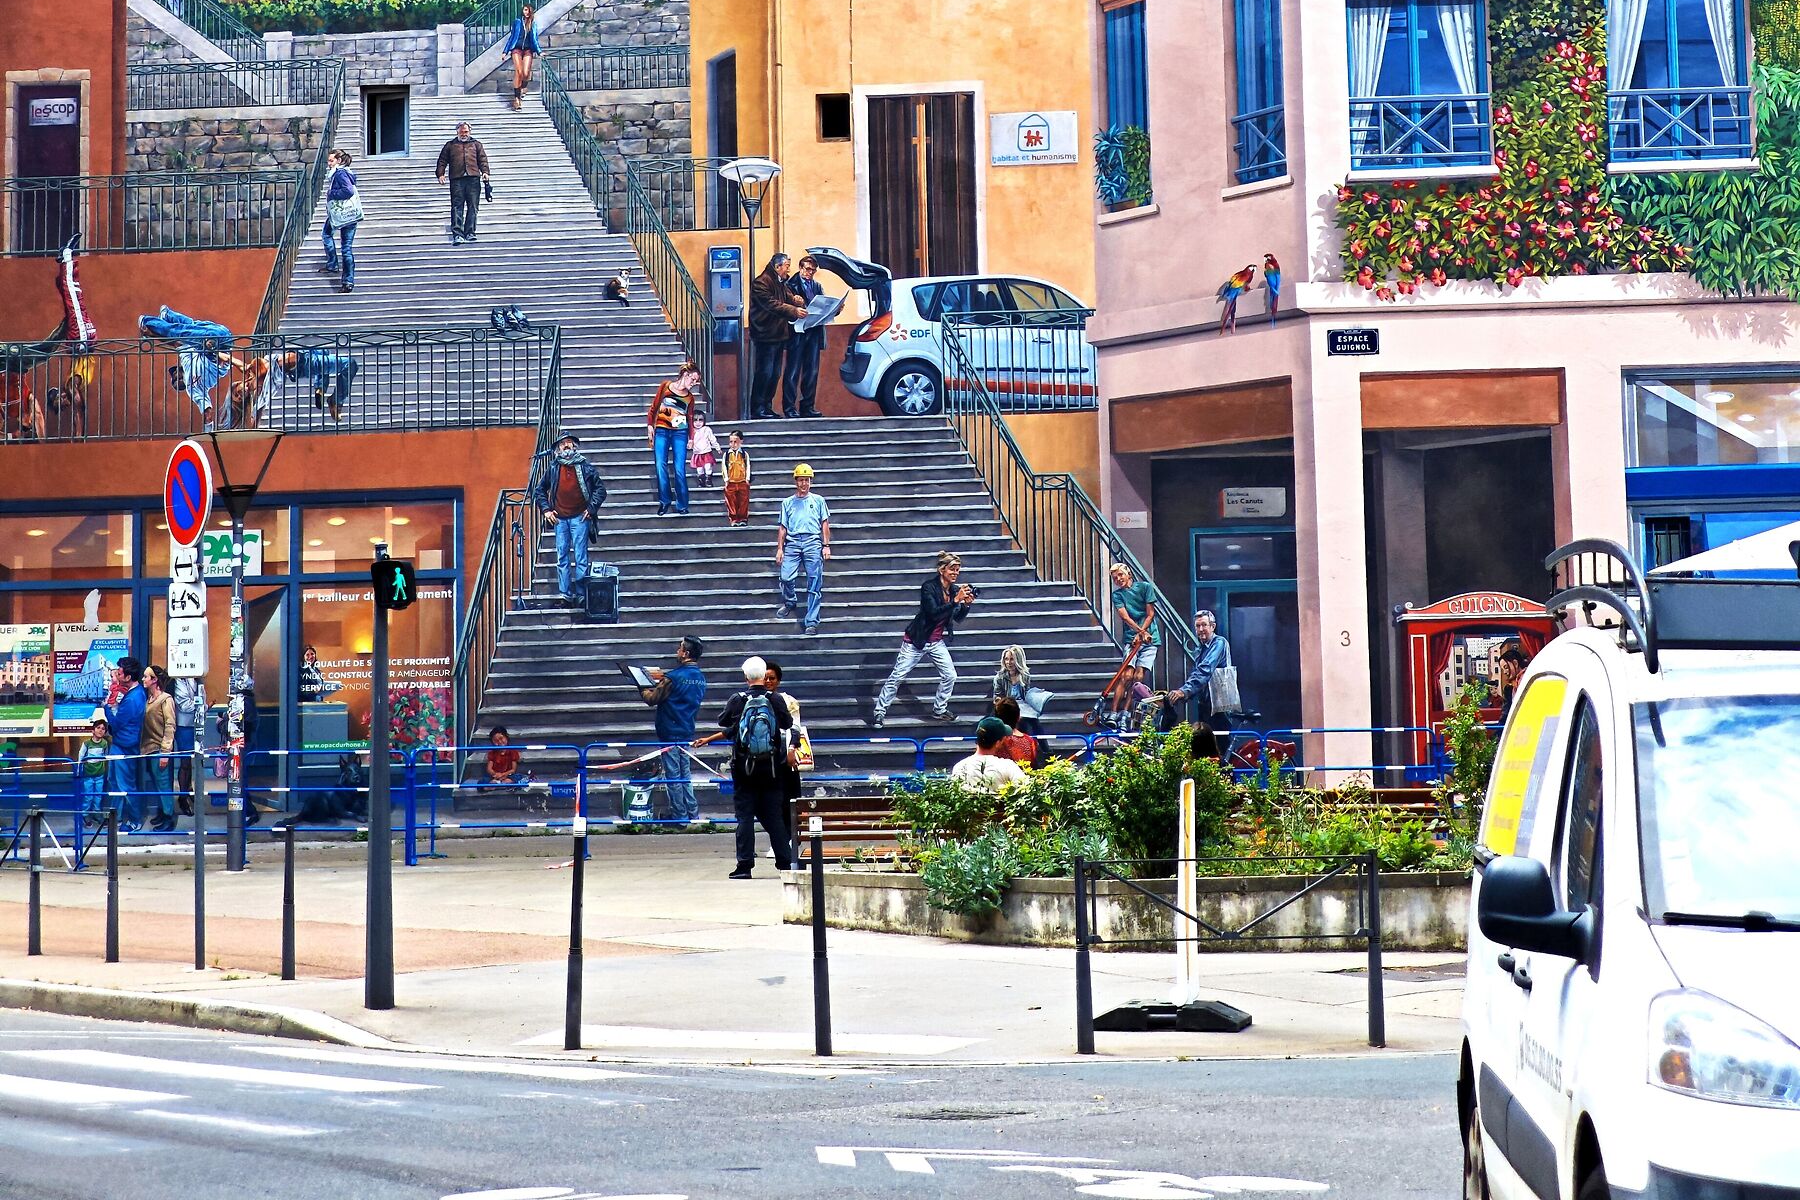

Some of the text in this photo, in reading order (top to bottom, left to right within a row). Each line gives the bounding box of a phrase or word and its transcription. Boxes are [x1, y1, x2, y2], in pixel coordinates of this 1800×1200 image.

[1021, 154, 1030, 162] et
[1031, 153, 1077, 161] humanisme
[1337, 335, 1369, 343] ESPACE
[203, 533, 260, 564] PAC
[317, 592, 360, 602] bailleur
[1448, 596, 1525, 614] GUIGNOL
[1340, 630, 1351, 647] 3
[314, 658, 351, 668] QUALITÉ
[352, 659, 364, 667] DE
[367, 658, 402, 668] SICE
[404, 656, 450, 666] PROXIMITÉ
[328, 670, 395, 679] CONSTRUCR
[397, 668, 451, 678] AMÉNAGEUR
[338, 682, 370, 691] SYNDIC
[409, 680, 451, 689] DURABLE
